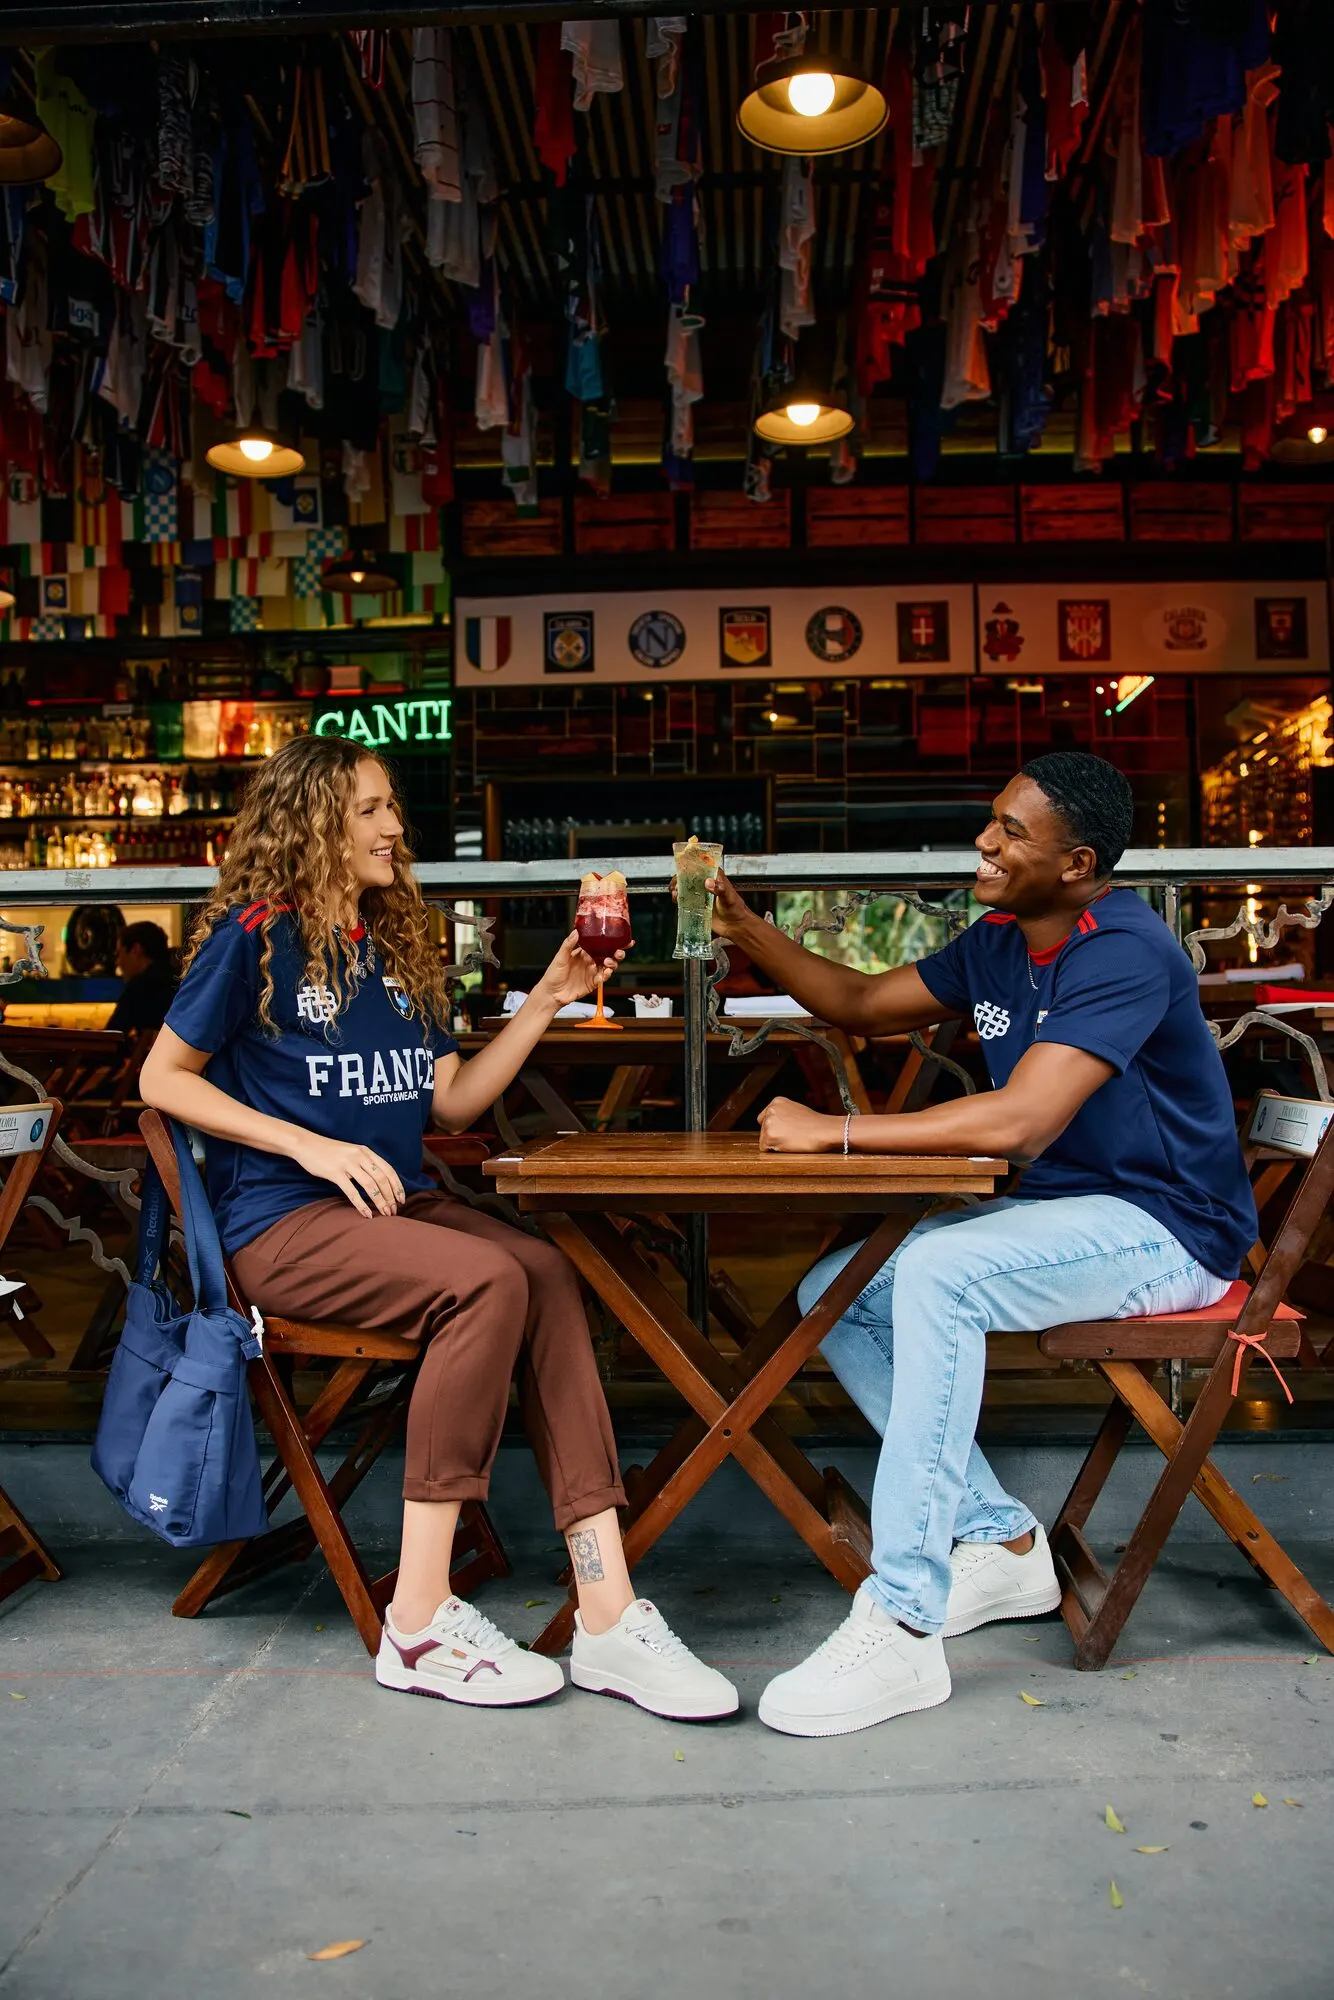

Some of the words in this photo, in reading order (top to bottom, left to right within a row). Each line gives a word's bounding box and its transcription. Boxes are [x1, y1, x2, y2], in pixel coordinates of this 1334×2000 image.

[646, 626, 669, 653] N
[315, 700, 452, 745] CANTI
[306, 1048, 435, 1097] FRANCE
[363, 1090, 419, 1106] SPORTY&WEAR
